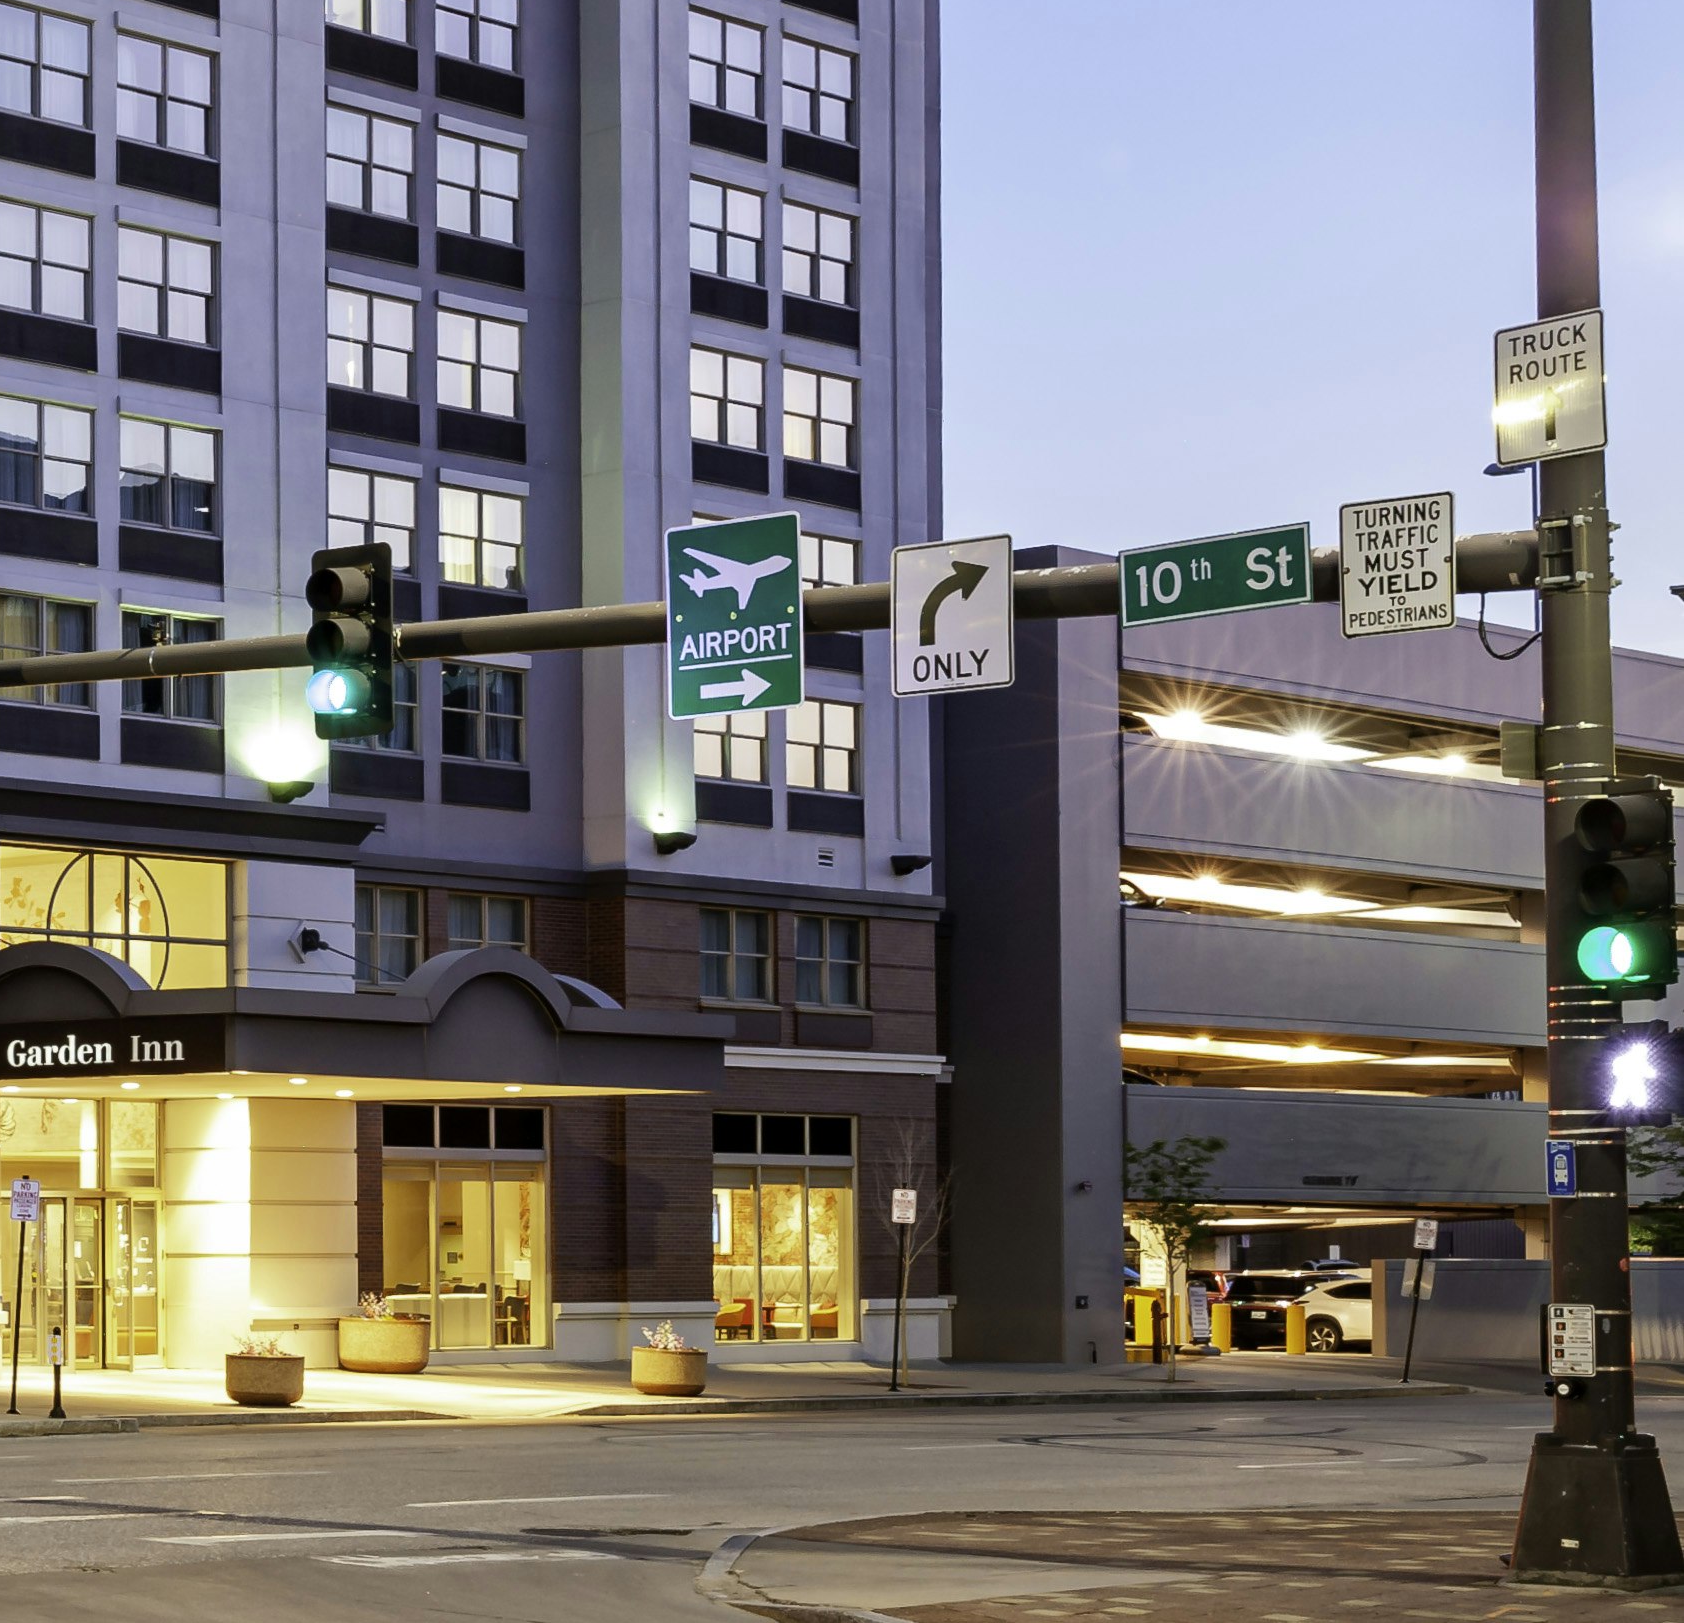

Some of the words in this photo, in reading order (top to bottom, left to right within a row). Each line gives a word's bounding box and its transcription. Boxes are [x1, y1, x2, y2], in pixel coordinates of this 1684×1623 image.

[1508, 322, 1586, 356] TRUCK
[1510, 350, 1587, 384] ROUTE
[1353, 500, 1441, 530] TURNING
[1355, 524, 1439, 552] TRAFFIC
[1135, 557, 1211, 608] 10th
[1245, 545, 1293, 590] St
[1364, 548, 1429, 574] MUST
[1358, 571, 1438, 597] YIELD
[1349, 603, 1448, 629] PEDESTRIANS
[1389, 595, 1406, 606] TO
[679, 622, 792, 661] AIRPORT
[913, 648, 989, 682] ONLY
[6, 1034, 114, 1067] Garden
[130, 1035, 185, 1063] Inn
